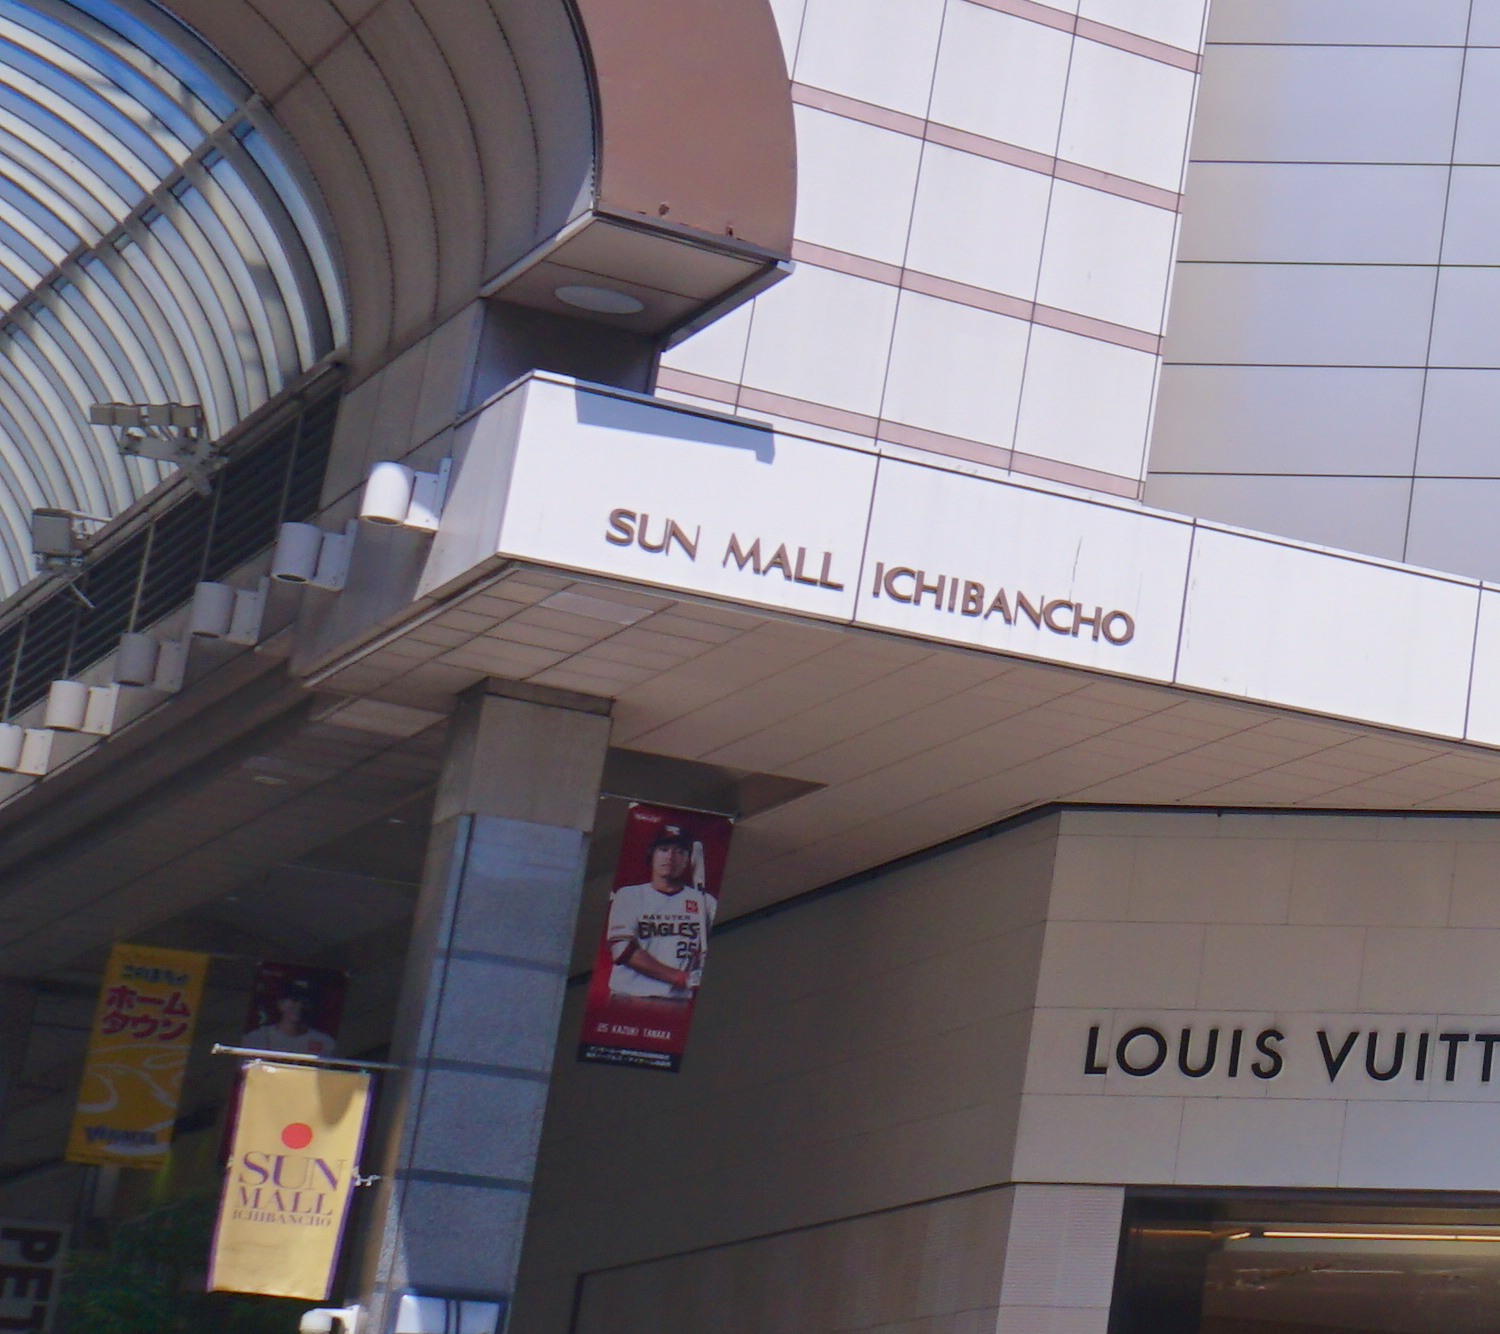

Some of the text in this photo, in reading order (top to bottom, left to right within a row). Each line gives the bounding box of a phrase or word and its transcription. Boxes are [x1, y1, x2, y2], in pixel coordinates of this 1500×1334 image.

[605, 508, 1135, 646] SUN MALL ICHIBANCHO
[638, 922, 700, 939] EAGLES
[106, 985, 190, 1016] ホーム
[102, 1010, 189, 1041] タウン
[1083, 1026, 1285, 1079] LOUIS
[239, 1151, 347, 1191] SUN
[237, 1186, 333, 1216] MALL
